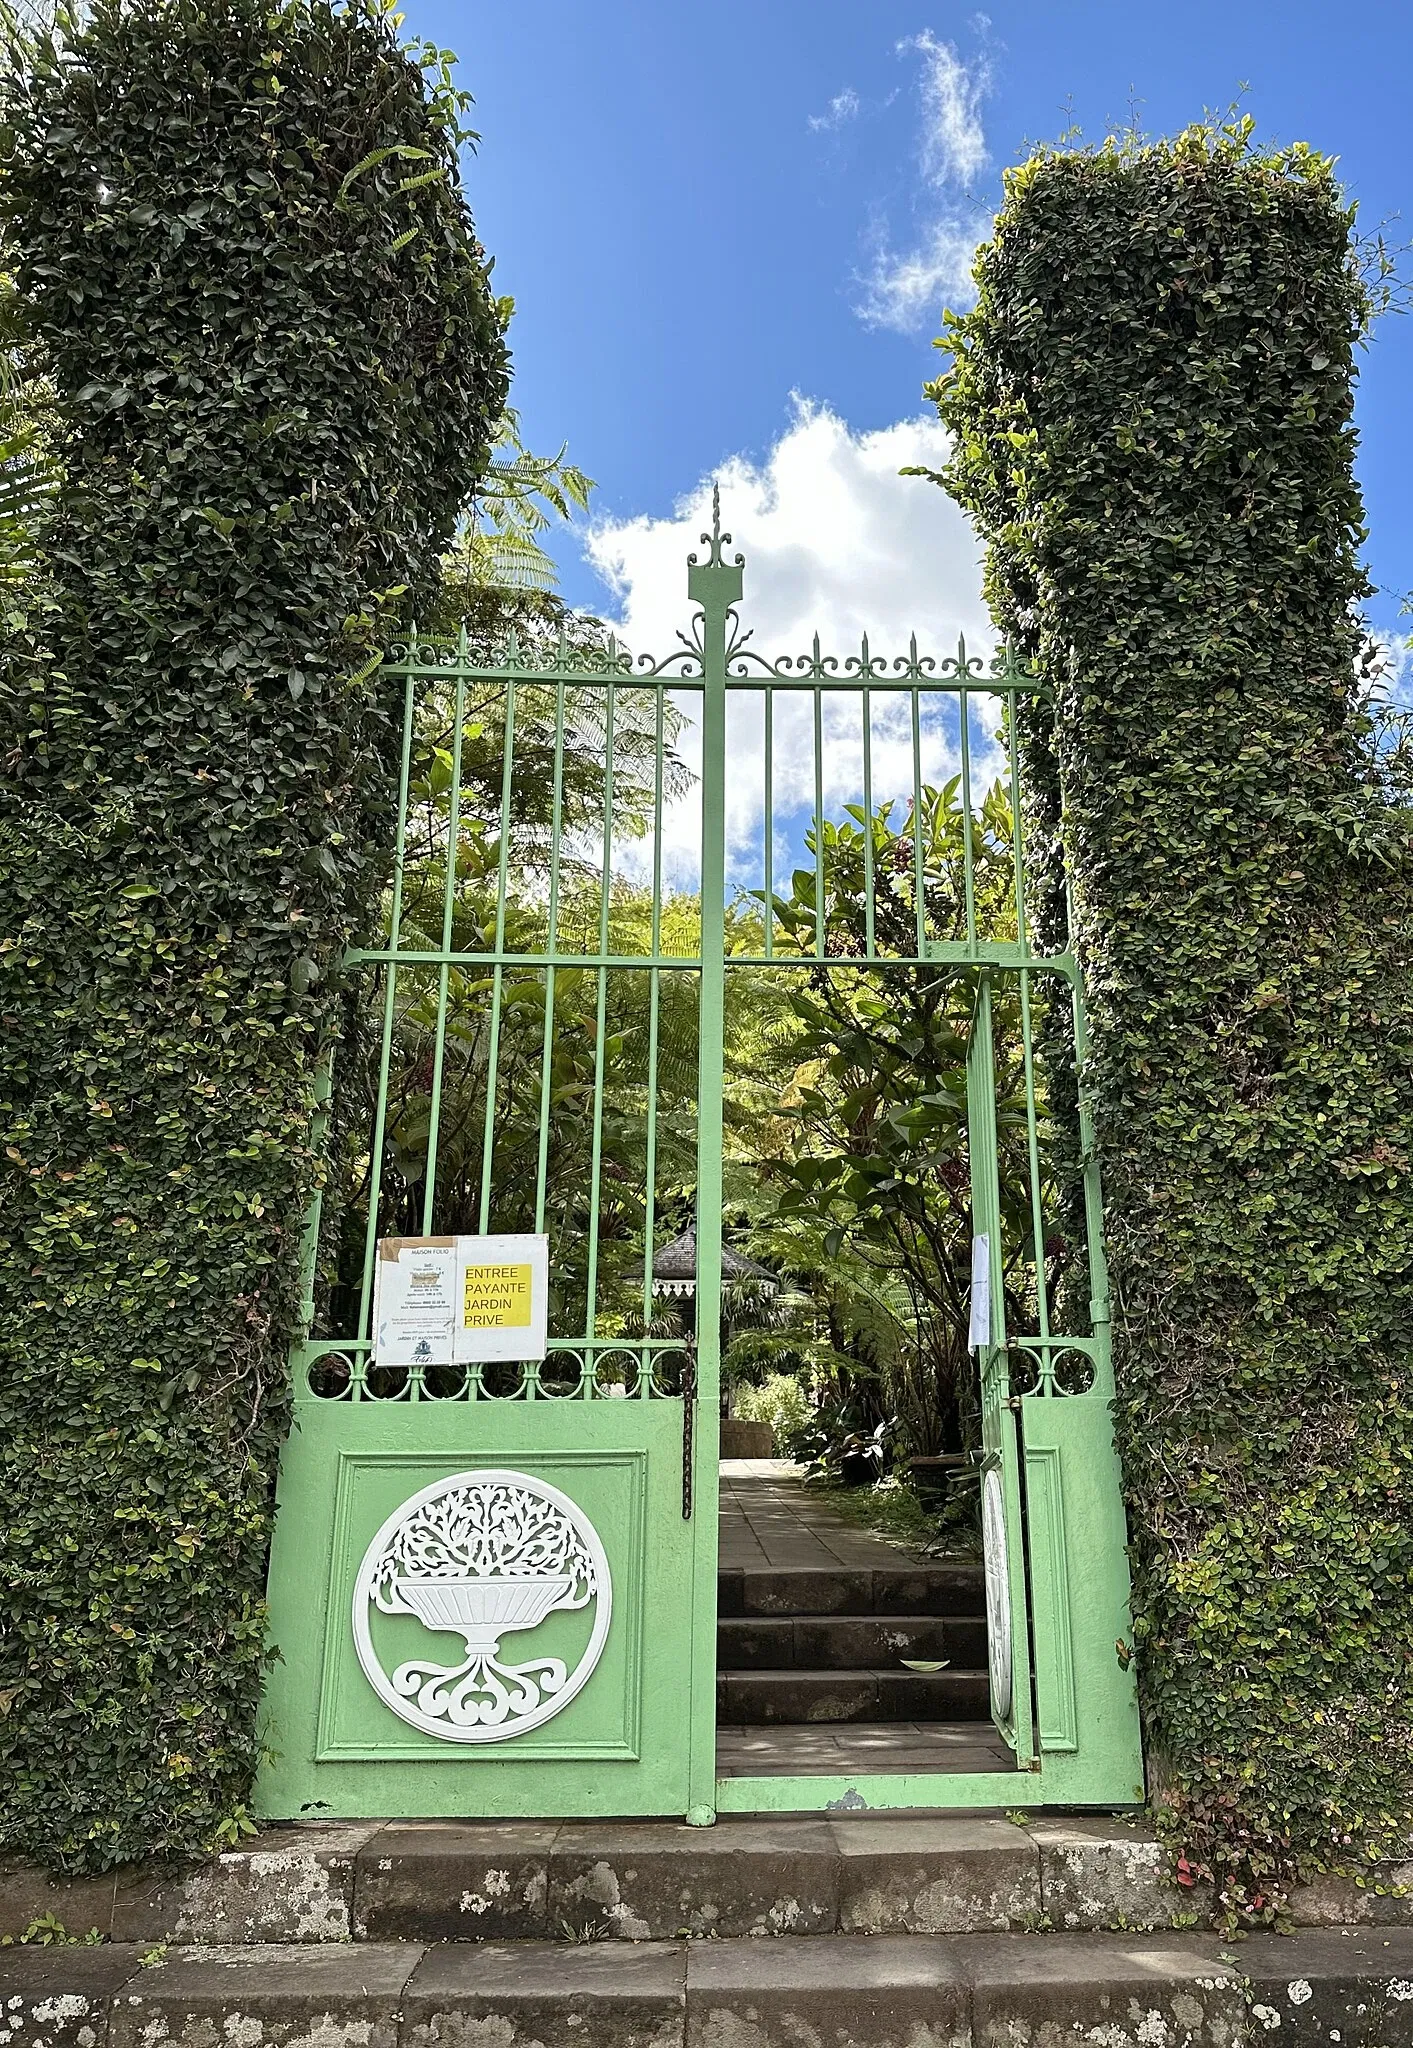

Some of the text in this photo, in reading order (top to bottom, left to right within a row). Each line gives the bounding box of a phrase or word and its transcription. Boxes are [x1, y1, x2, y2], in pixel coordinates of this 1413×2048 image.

[465, 1267, 519, 1279] ENTREE
[465, 1282, 526, 1295] PAYANTE
[464, 1298, 512, 1310] JARDIN
[464, 1314, 504, 1326] PRIVE
